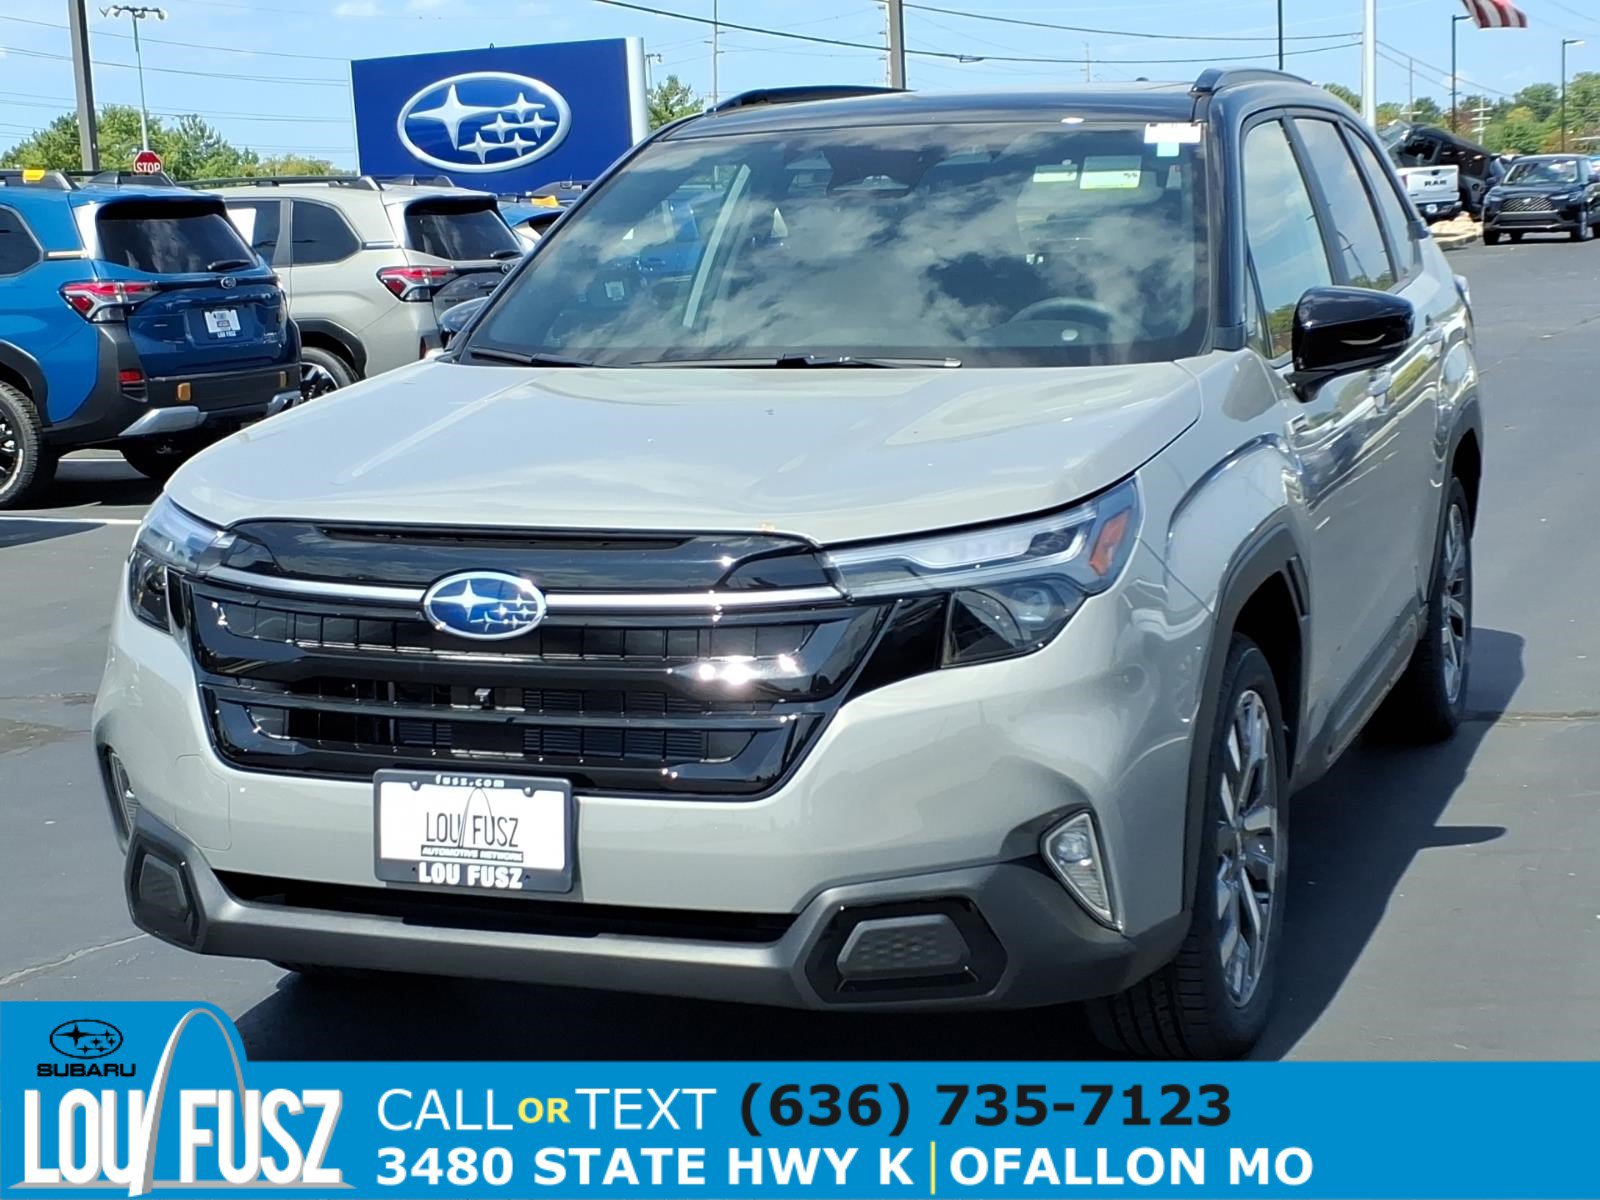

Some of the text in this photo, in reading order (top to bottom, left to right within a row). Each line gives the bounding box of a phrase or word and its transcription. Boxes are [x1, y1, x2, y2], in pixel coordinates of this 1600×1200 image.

[136, 162, 161, 173] STOP
[435, 774, 505, 788] fusz.com
[426, 812, 519, 848] LOU FUSZ
[419, 861, 523, 889] LOU FUSZ
